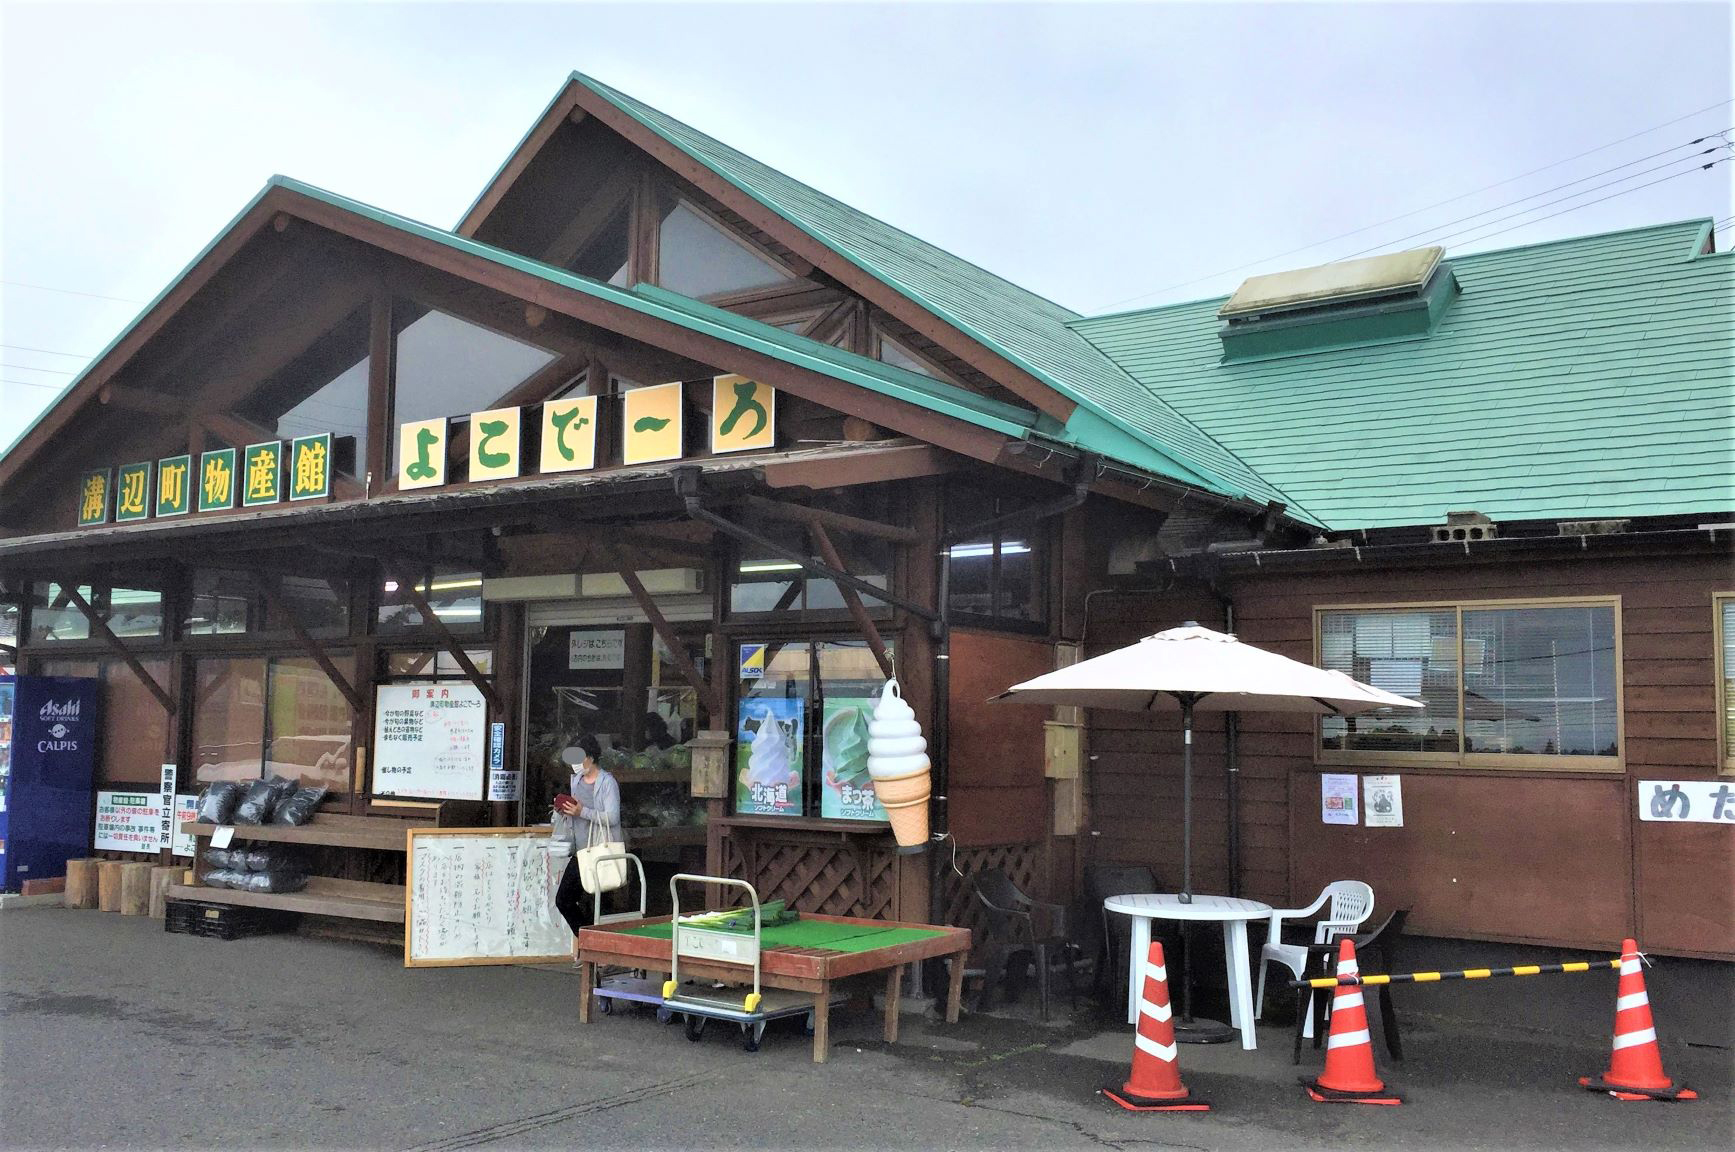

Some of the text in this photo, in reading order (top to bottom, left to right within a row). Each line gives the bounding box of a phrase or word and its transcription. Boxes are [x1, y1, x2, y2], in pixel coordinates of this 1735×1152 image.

[81, 442, 326, 521] 溝辺町物産館
[39, 699, 81, 716] Asahi
[37, 740, 78, 753] CALPIS
[160, 768, 173, 844] 警察官立寄所
[751, 783, 788, 806] 北海道
[841, 784, 875, 811] まつ茶
[841, 809, 875, 817] ソフトクリーム
